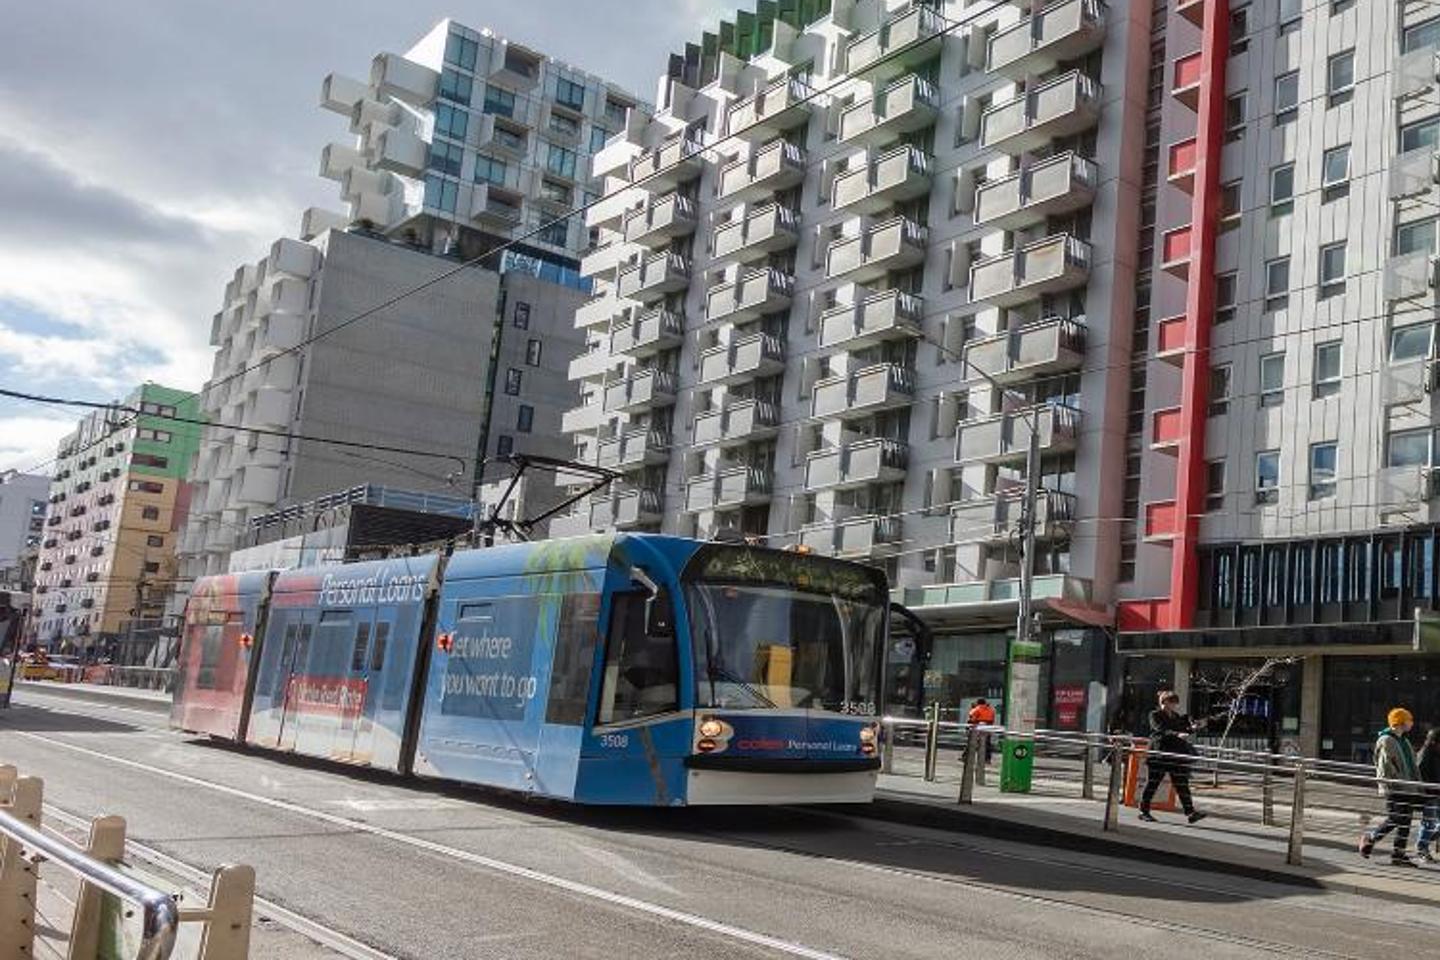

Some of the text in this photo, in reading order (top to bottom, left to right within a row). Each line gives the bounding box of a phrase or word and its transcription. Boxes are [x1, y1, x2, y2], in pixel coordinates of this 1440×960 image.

[318, 568, 427, 605] Personal Loans
[469, 628, 512, 658] where
[462, 671, 499, 698] want
[500, 672, 516, 698] to
[517, 677, 537, 708] go
[840, 702, 876, 716] 3508
[600, 734, 629, 748] 3508
[788, 739, 832, 752] Personal
[832, 742, 857, 753] Loans
